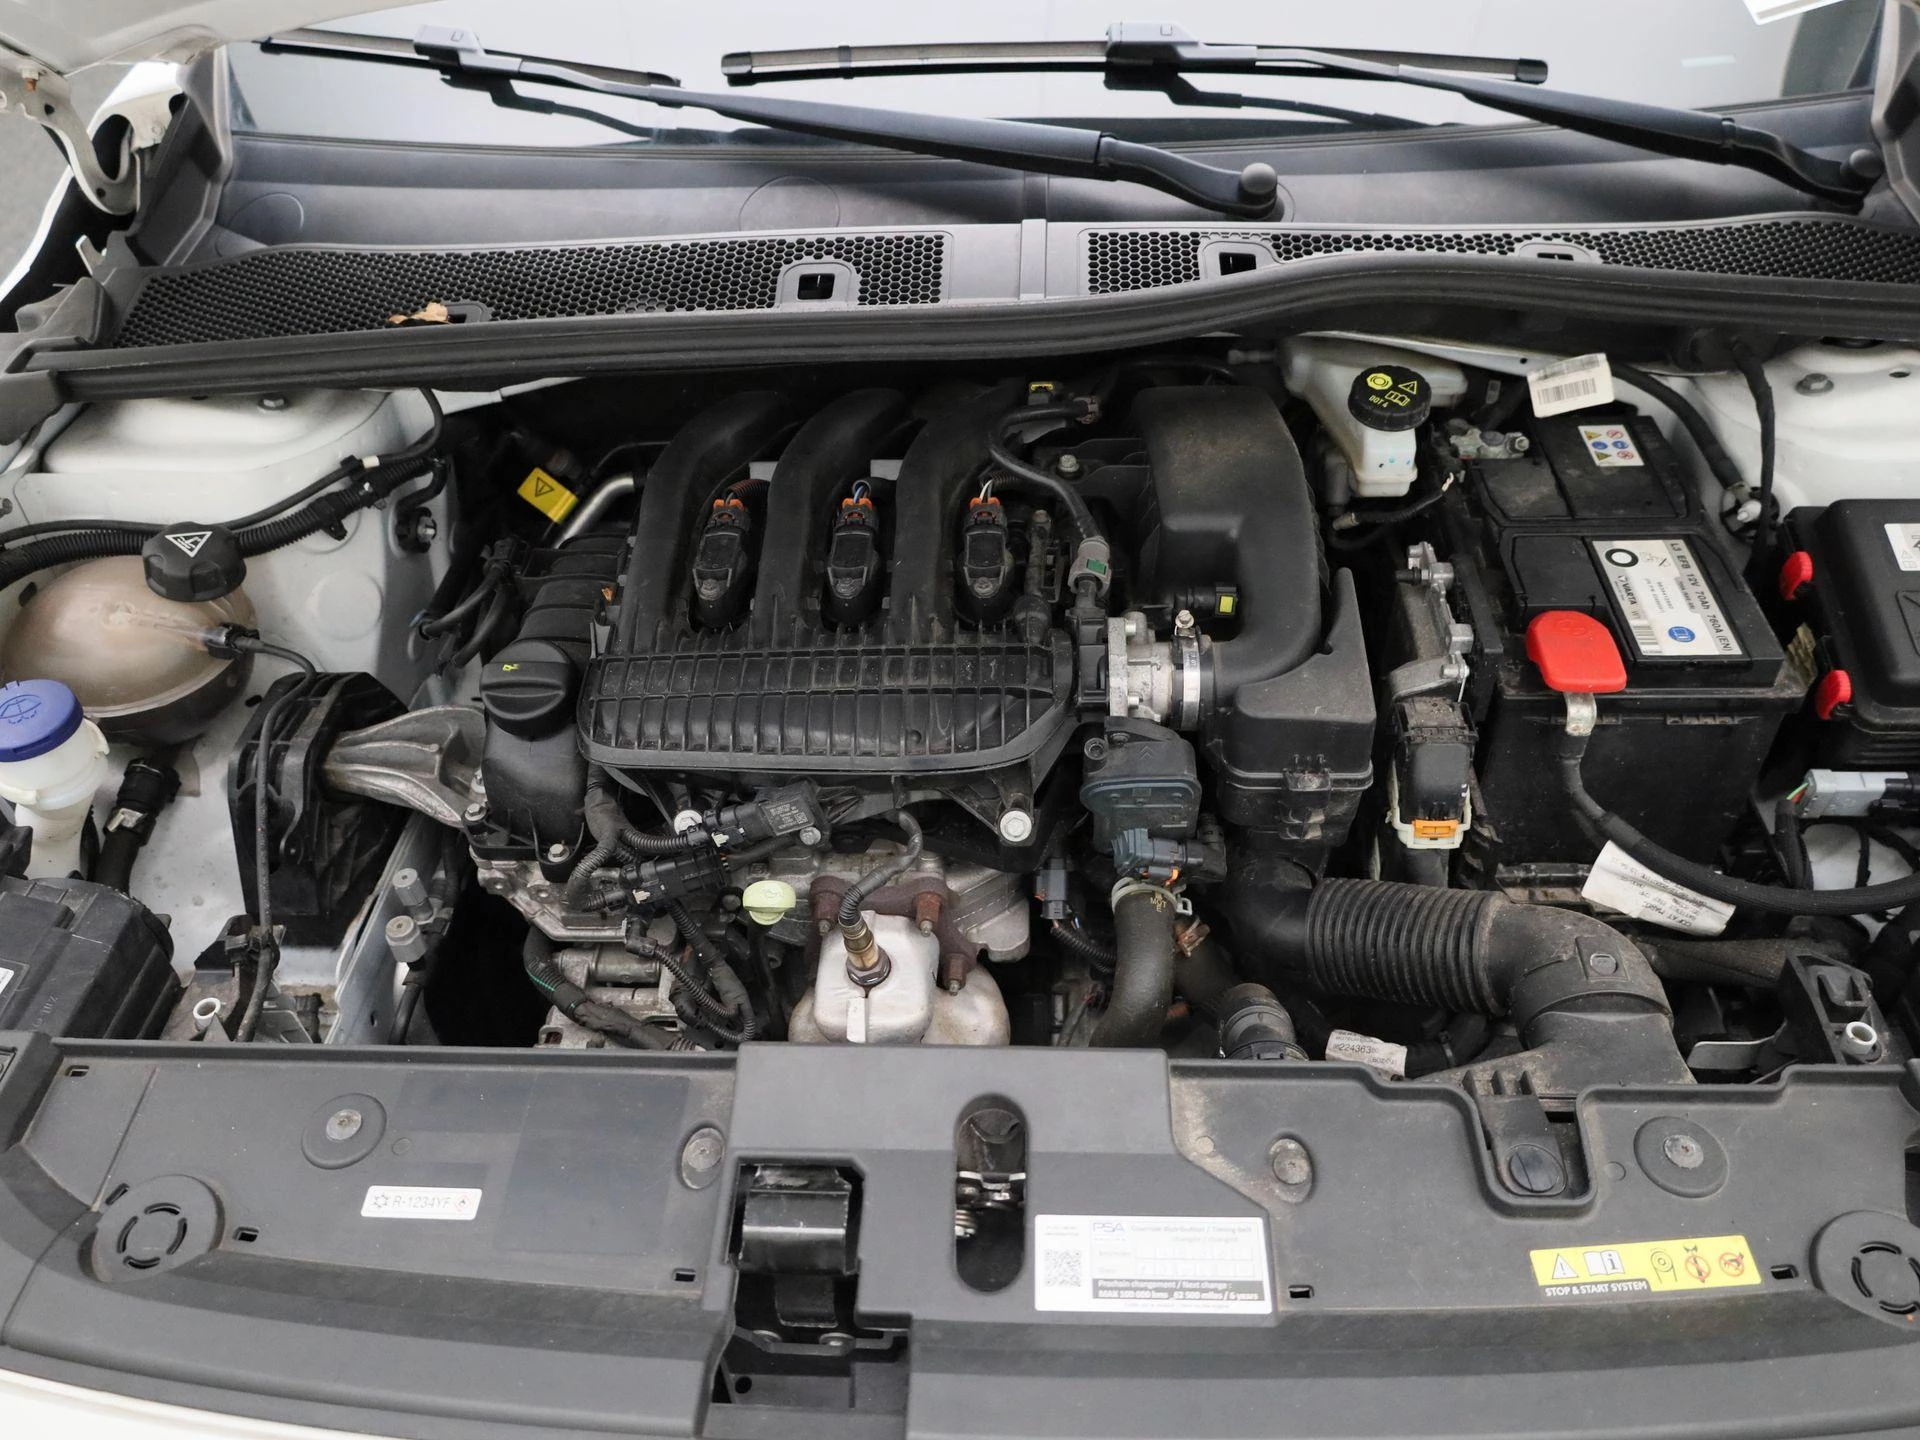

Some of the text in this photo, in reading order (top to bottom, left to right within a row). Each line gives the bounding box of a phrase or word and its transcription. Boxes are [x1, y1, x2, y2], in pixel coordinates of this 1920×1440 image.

[1369, 394, 1384, 405] DOT
[1622, 582, 1637, 605] VARTA
[1671, 542, 1682, 552] L3
[1677, 555, 1691, 569] EFB
[1686, 574, 1701, 587] 12V
[1696, 591, 1710, 610] 70Ah
[1707, 614, 1723, 633] 760A
[1716, 634, 1733, 651] (EN)
[392, 1195, 452, 1209] R-1234YF
[1093, 1222, 1126, 1233] PSA
[1098, 1280, 1130, 1288] Prochain
[1131, 1281, 1176, 1290] changement
[1182, 1281, 1200, 1289] Next
[1545, 1280, 1648, 1297] STOP & START SYSTEM
[1098, 1290, 1119, 1298] MAX
[1201, 1291, 1223, 1300] miles
[1236, 1293, 1259, 1302] years
